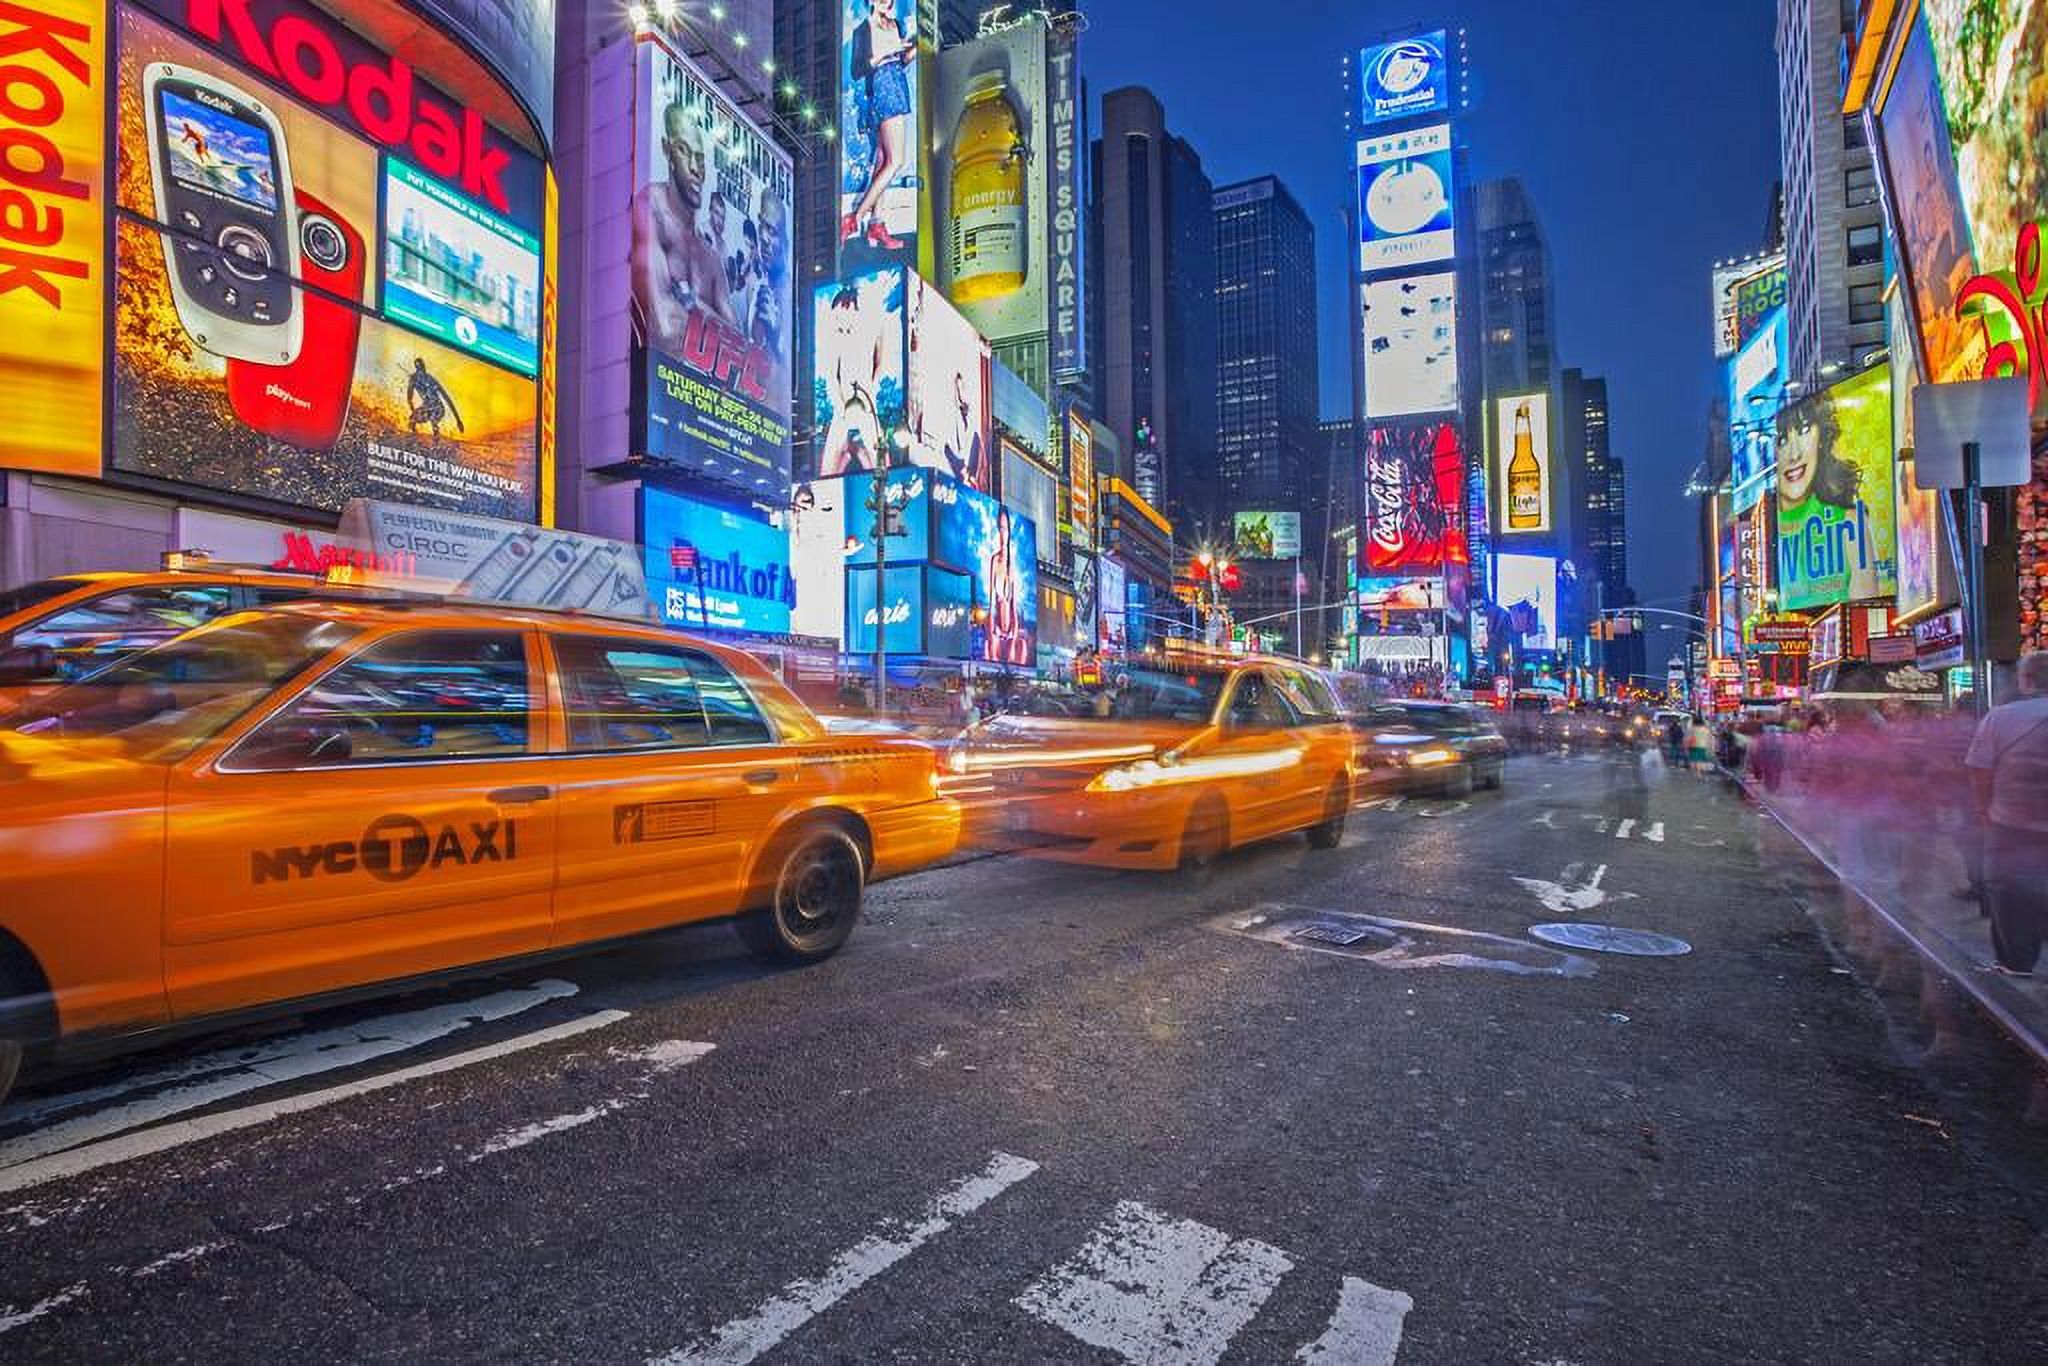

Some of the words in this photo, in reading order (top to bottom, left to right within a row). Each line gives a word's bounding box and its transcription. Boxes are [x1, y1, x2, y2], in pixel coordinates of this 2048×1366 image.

[1051, 53, 1074, 172] TIMES
[0, 0, 92, 310] Kodak
[1053, 184, 1076, 338] SQUARE
[657, 363, 720, 404] SATURDAY
[683, 313, 771, 401] UFC
[666, 381, 694, 406] LIVE
[695, 395, 713, 415] ON
[367, 442, 401, 462] BUILT
[401, 449, 426, 469] FOR
[427, 457, 449, 475] THE
[449, 463, 474, 482] WAY
[671, 536, 749, 597] Bank
[751, 561, 780, 602] of
[1804, 498, 1867, 580] Girl
[251, 841, 358, 886] NYC
[359, 813, 518, 884] TAXI
